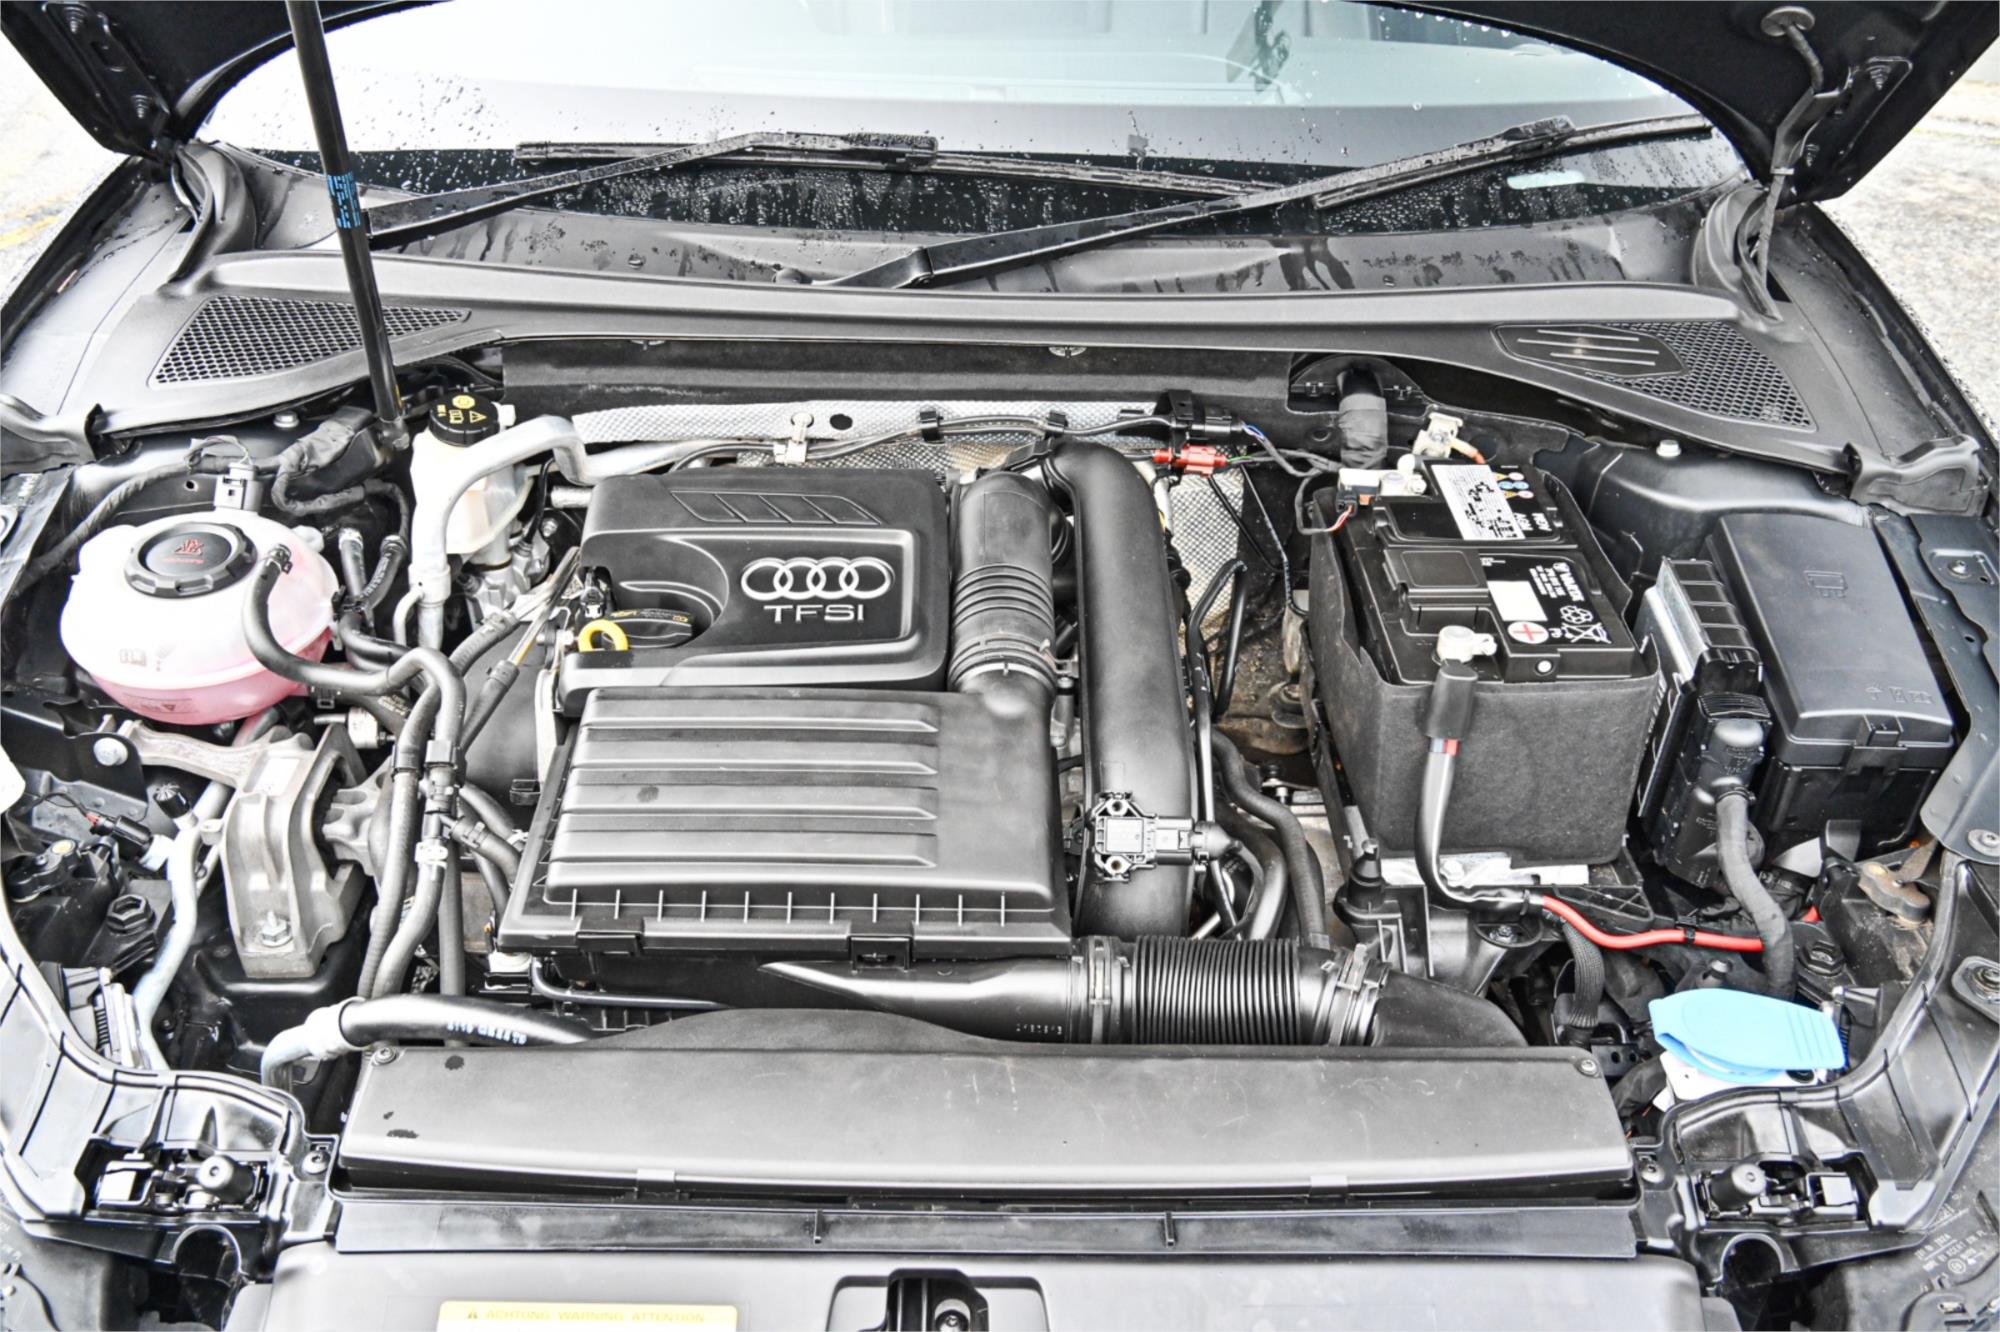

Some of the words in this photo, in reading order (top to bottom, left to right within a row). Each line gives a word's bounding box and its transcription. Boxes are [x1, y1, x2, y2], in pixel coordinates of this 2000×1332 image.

[1560, 571, 1585, 601] VARTA
[763, 604, 864, 623] TFSI
[485, 1310, 550, 1320] ACHTUNG
[558, 1311, 624, 1321] WARNING
[632, 1312, 705, 1322] ATTENTION
